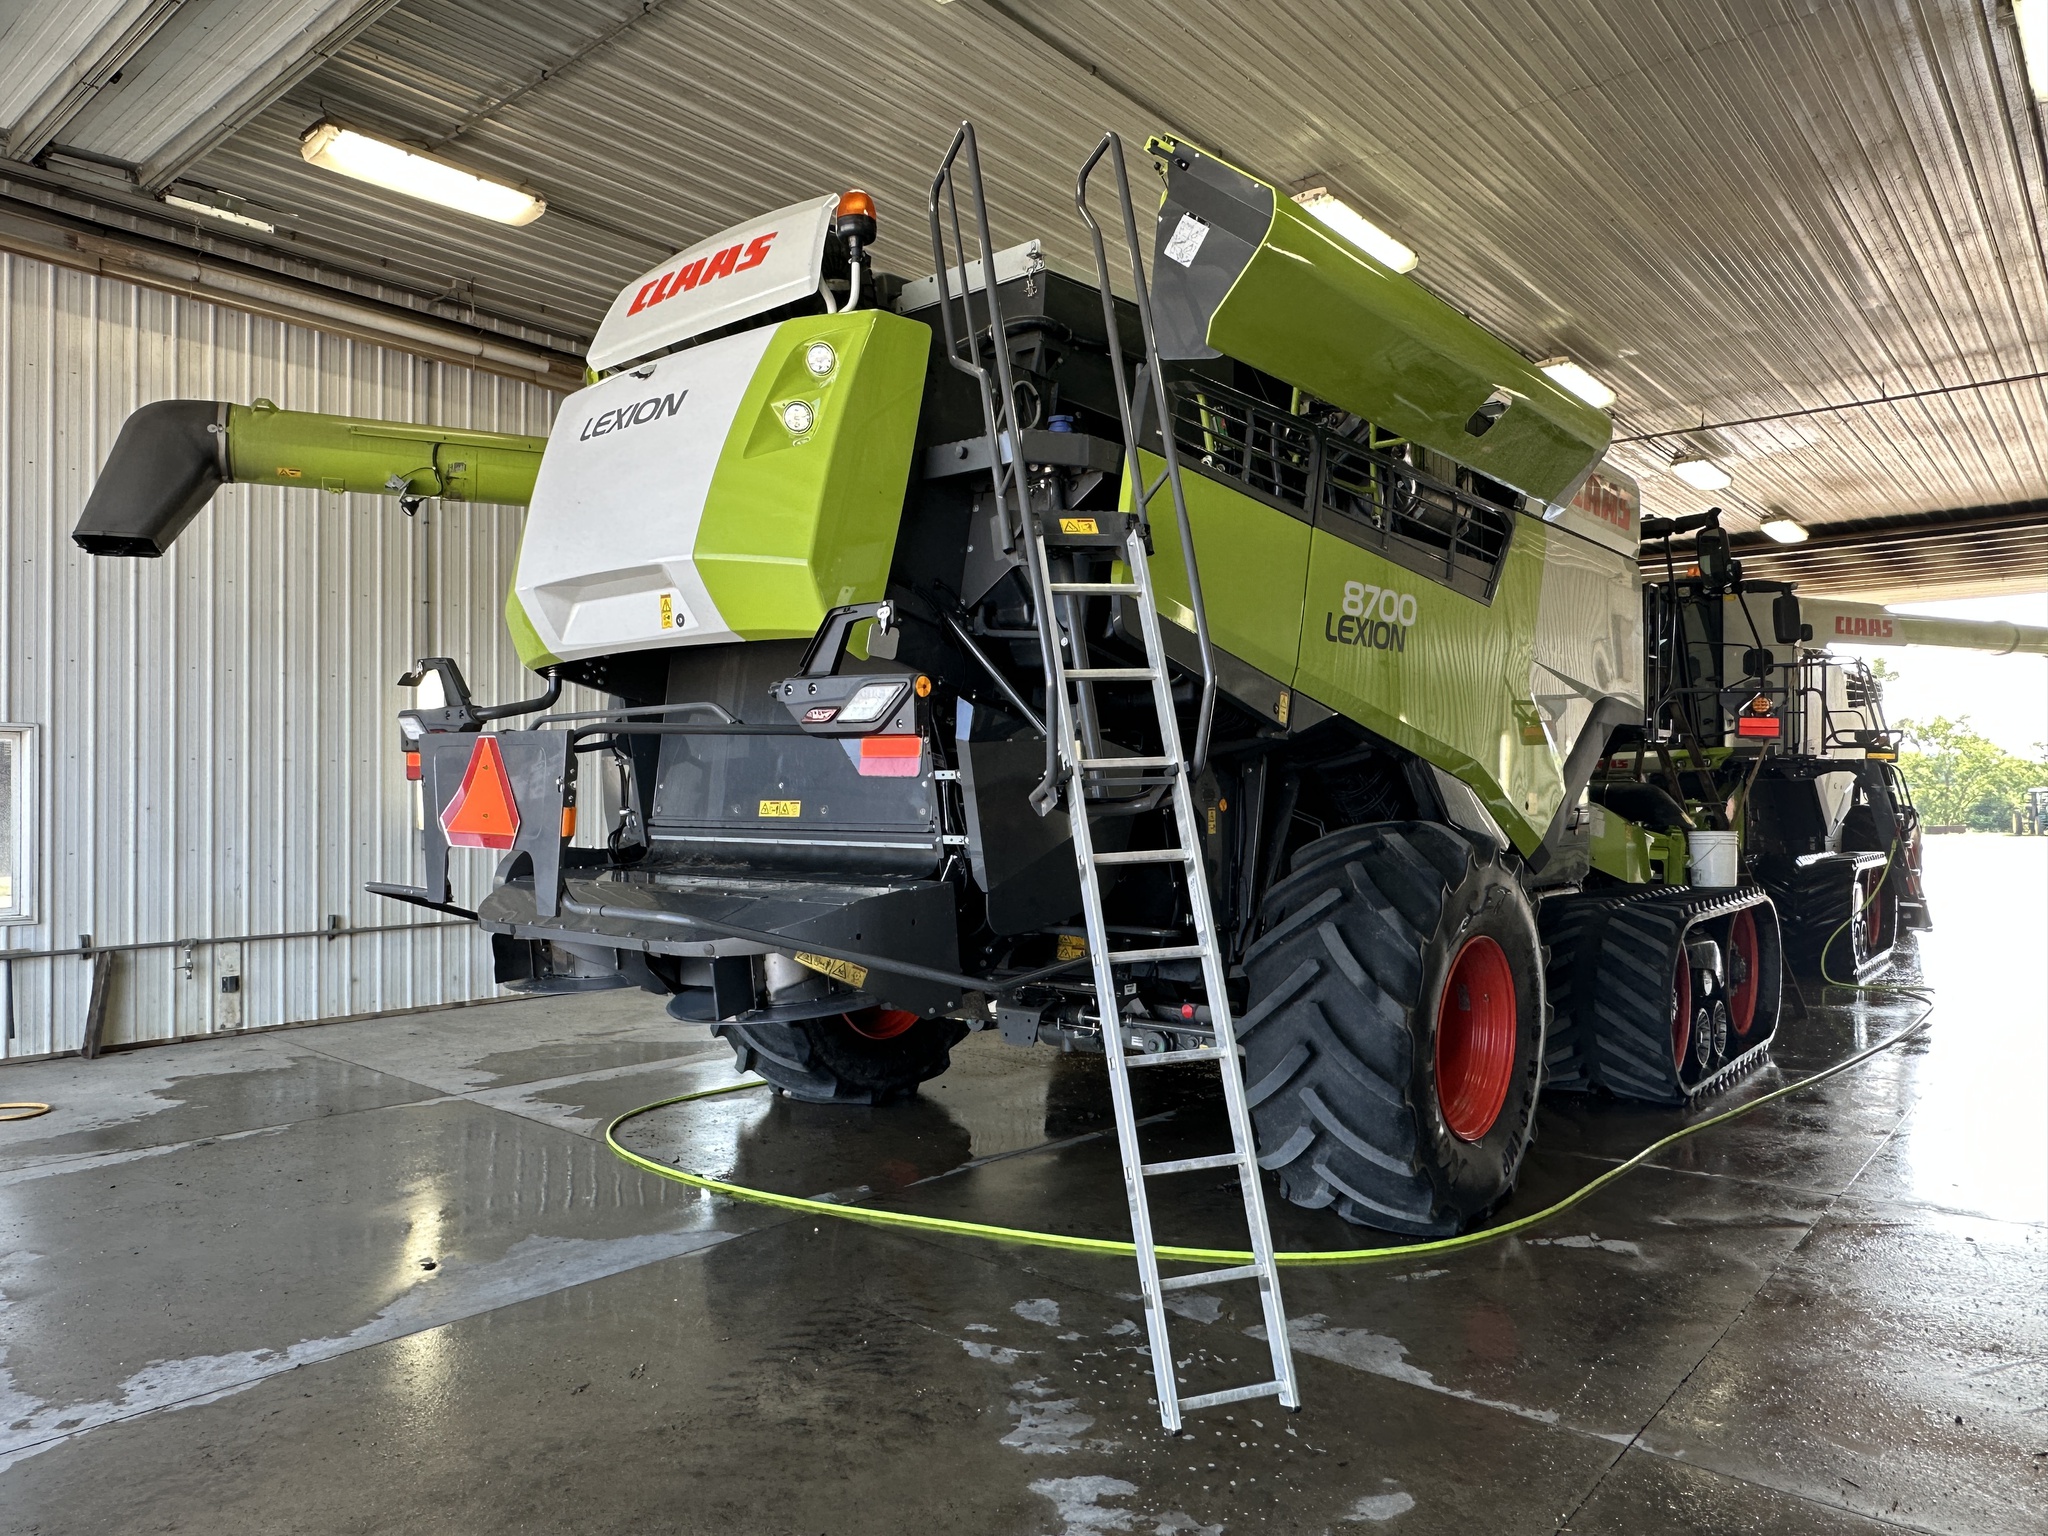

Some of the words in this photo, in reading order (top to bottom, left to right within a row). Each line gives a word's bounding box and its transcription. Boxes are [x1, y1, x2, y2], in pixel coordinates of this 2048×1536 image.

[626, 231, 779, 318] CLAAS
[579, 389, 689, 442] LEXION
[1572, 473, 1631, 531] AAS
[1342, 580, 1418, 627] 8700
[1835, 616, 1893, 638] CLAAS
[1325, 611, 1407, 653] LEXION
